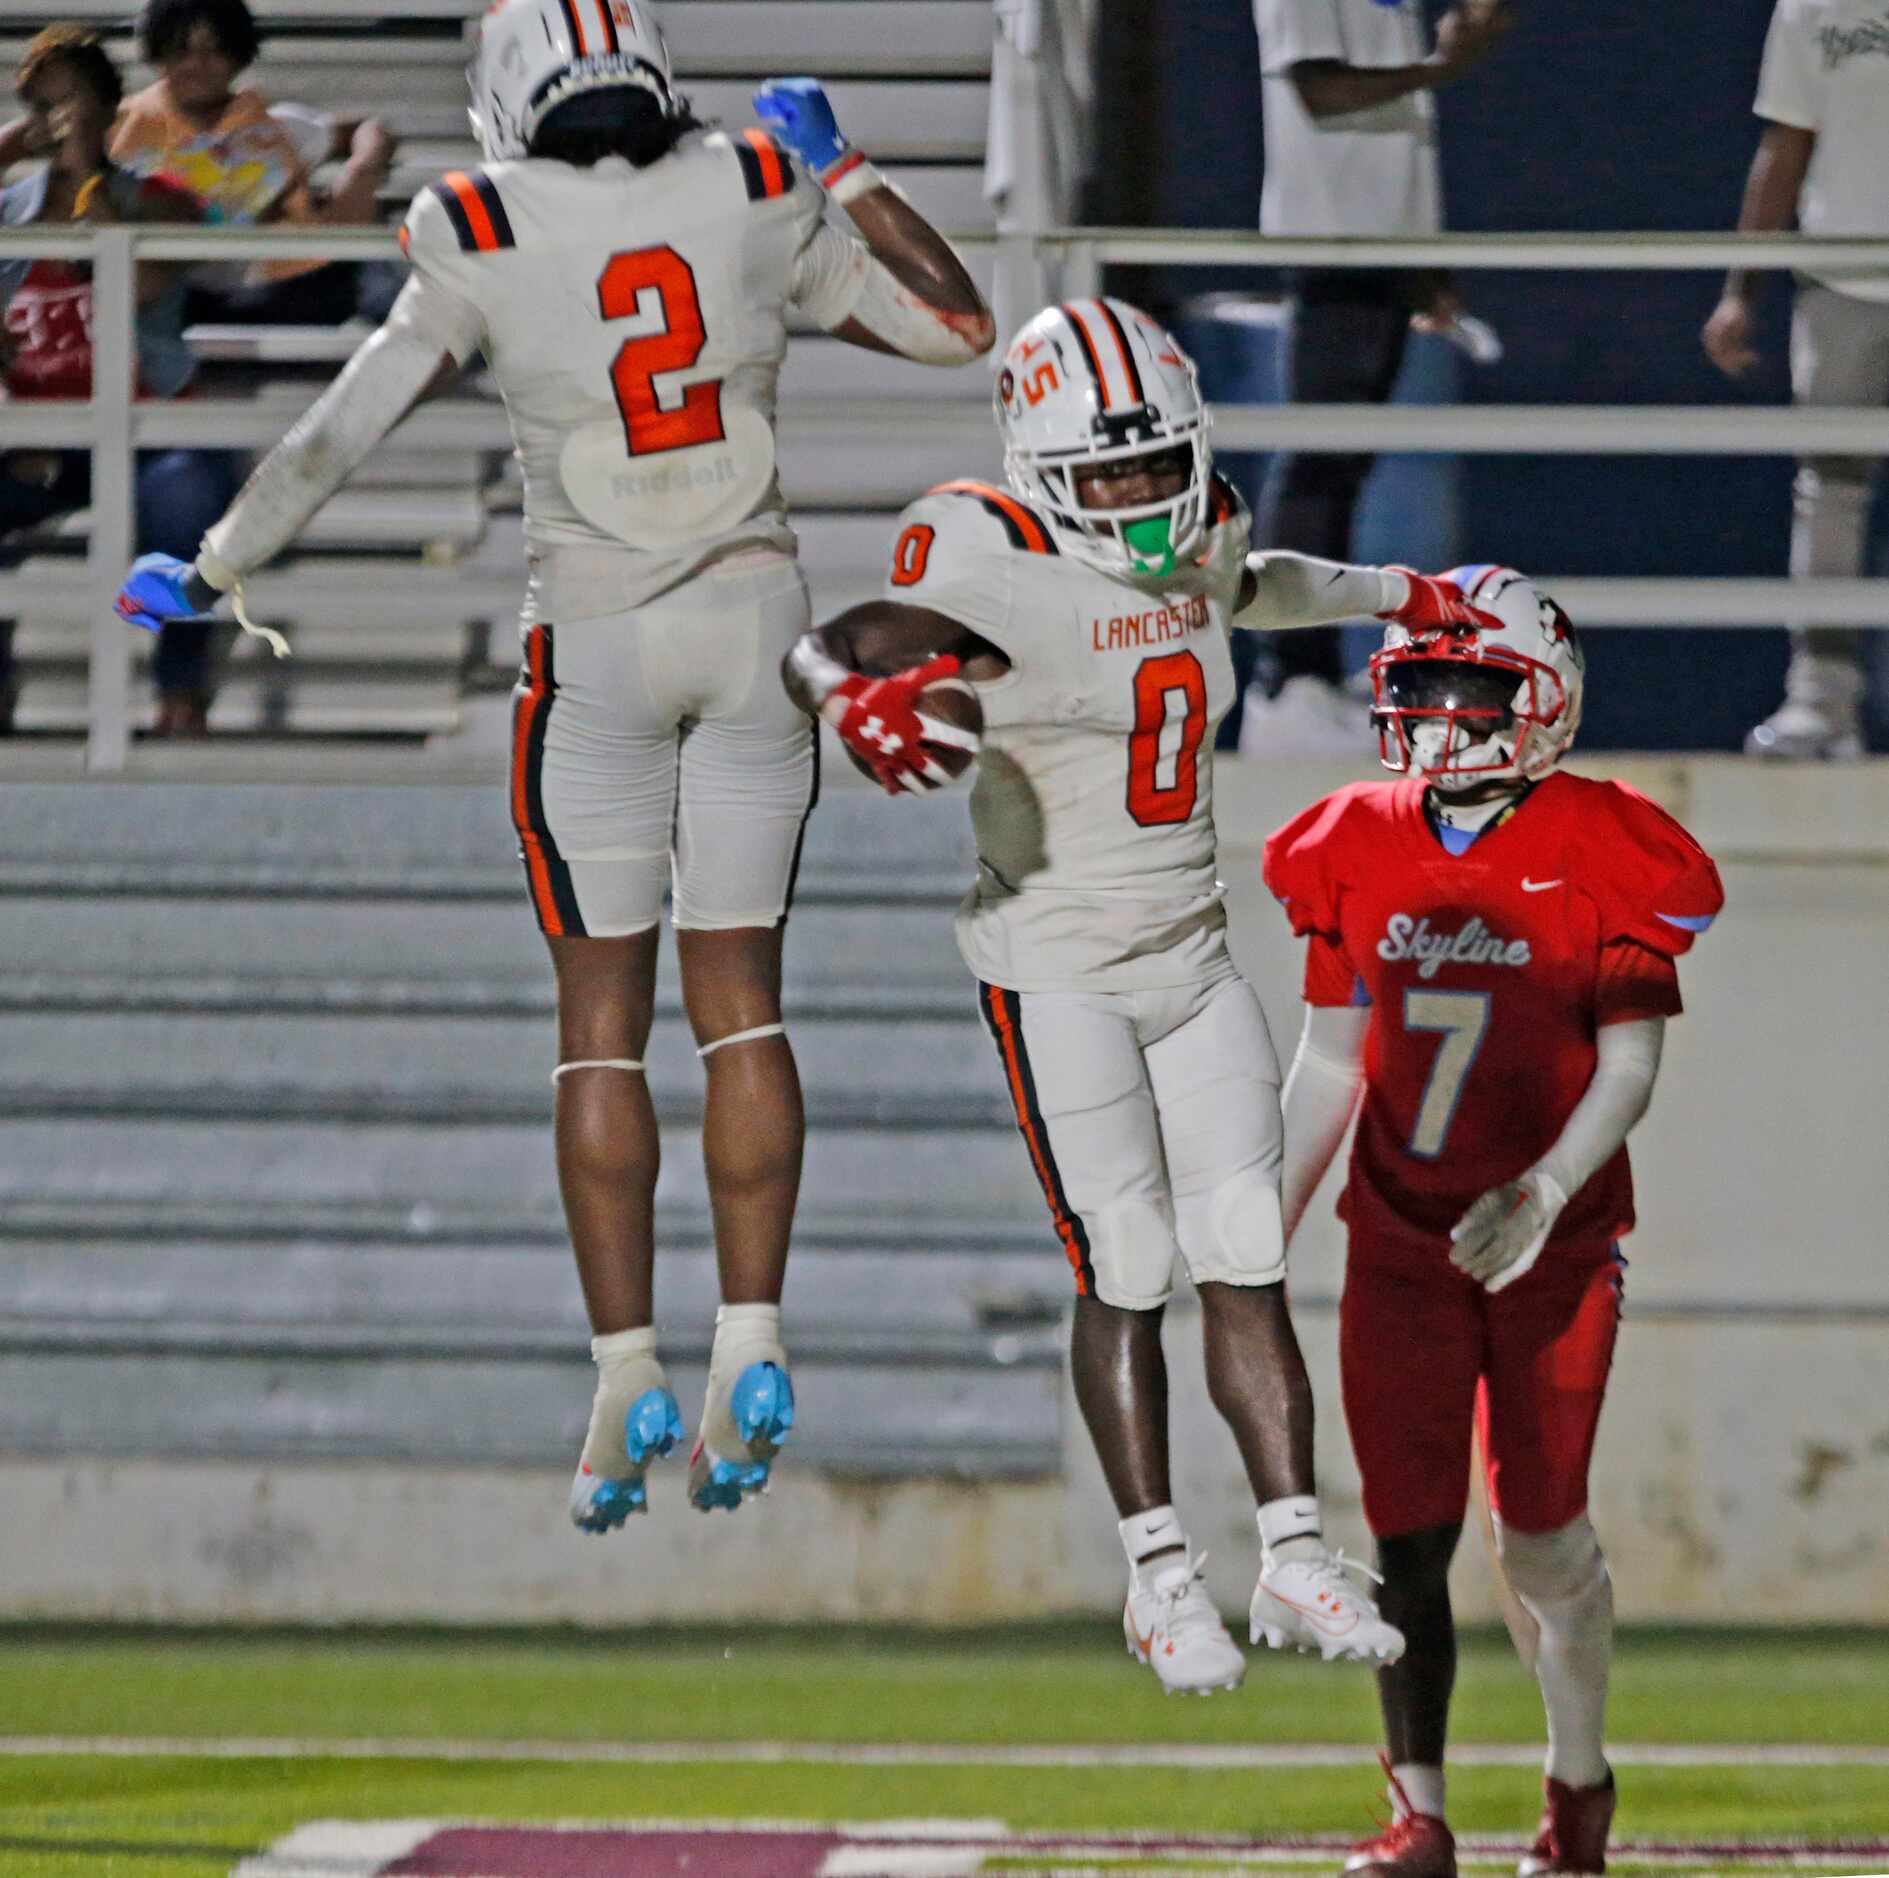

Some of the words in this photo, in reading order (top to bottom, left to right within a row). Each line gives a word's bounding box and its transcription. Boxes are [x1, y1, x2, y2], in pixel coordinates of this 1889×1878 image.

[596, 241, 726, 456] 2
[891, 523, 935, 587] 0
[1125, 648, 1207, 827] 0
[1376, 912, 1532, 979] Skyline
[1402, 986, 1492, 1160] 7
